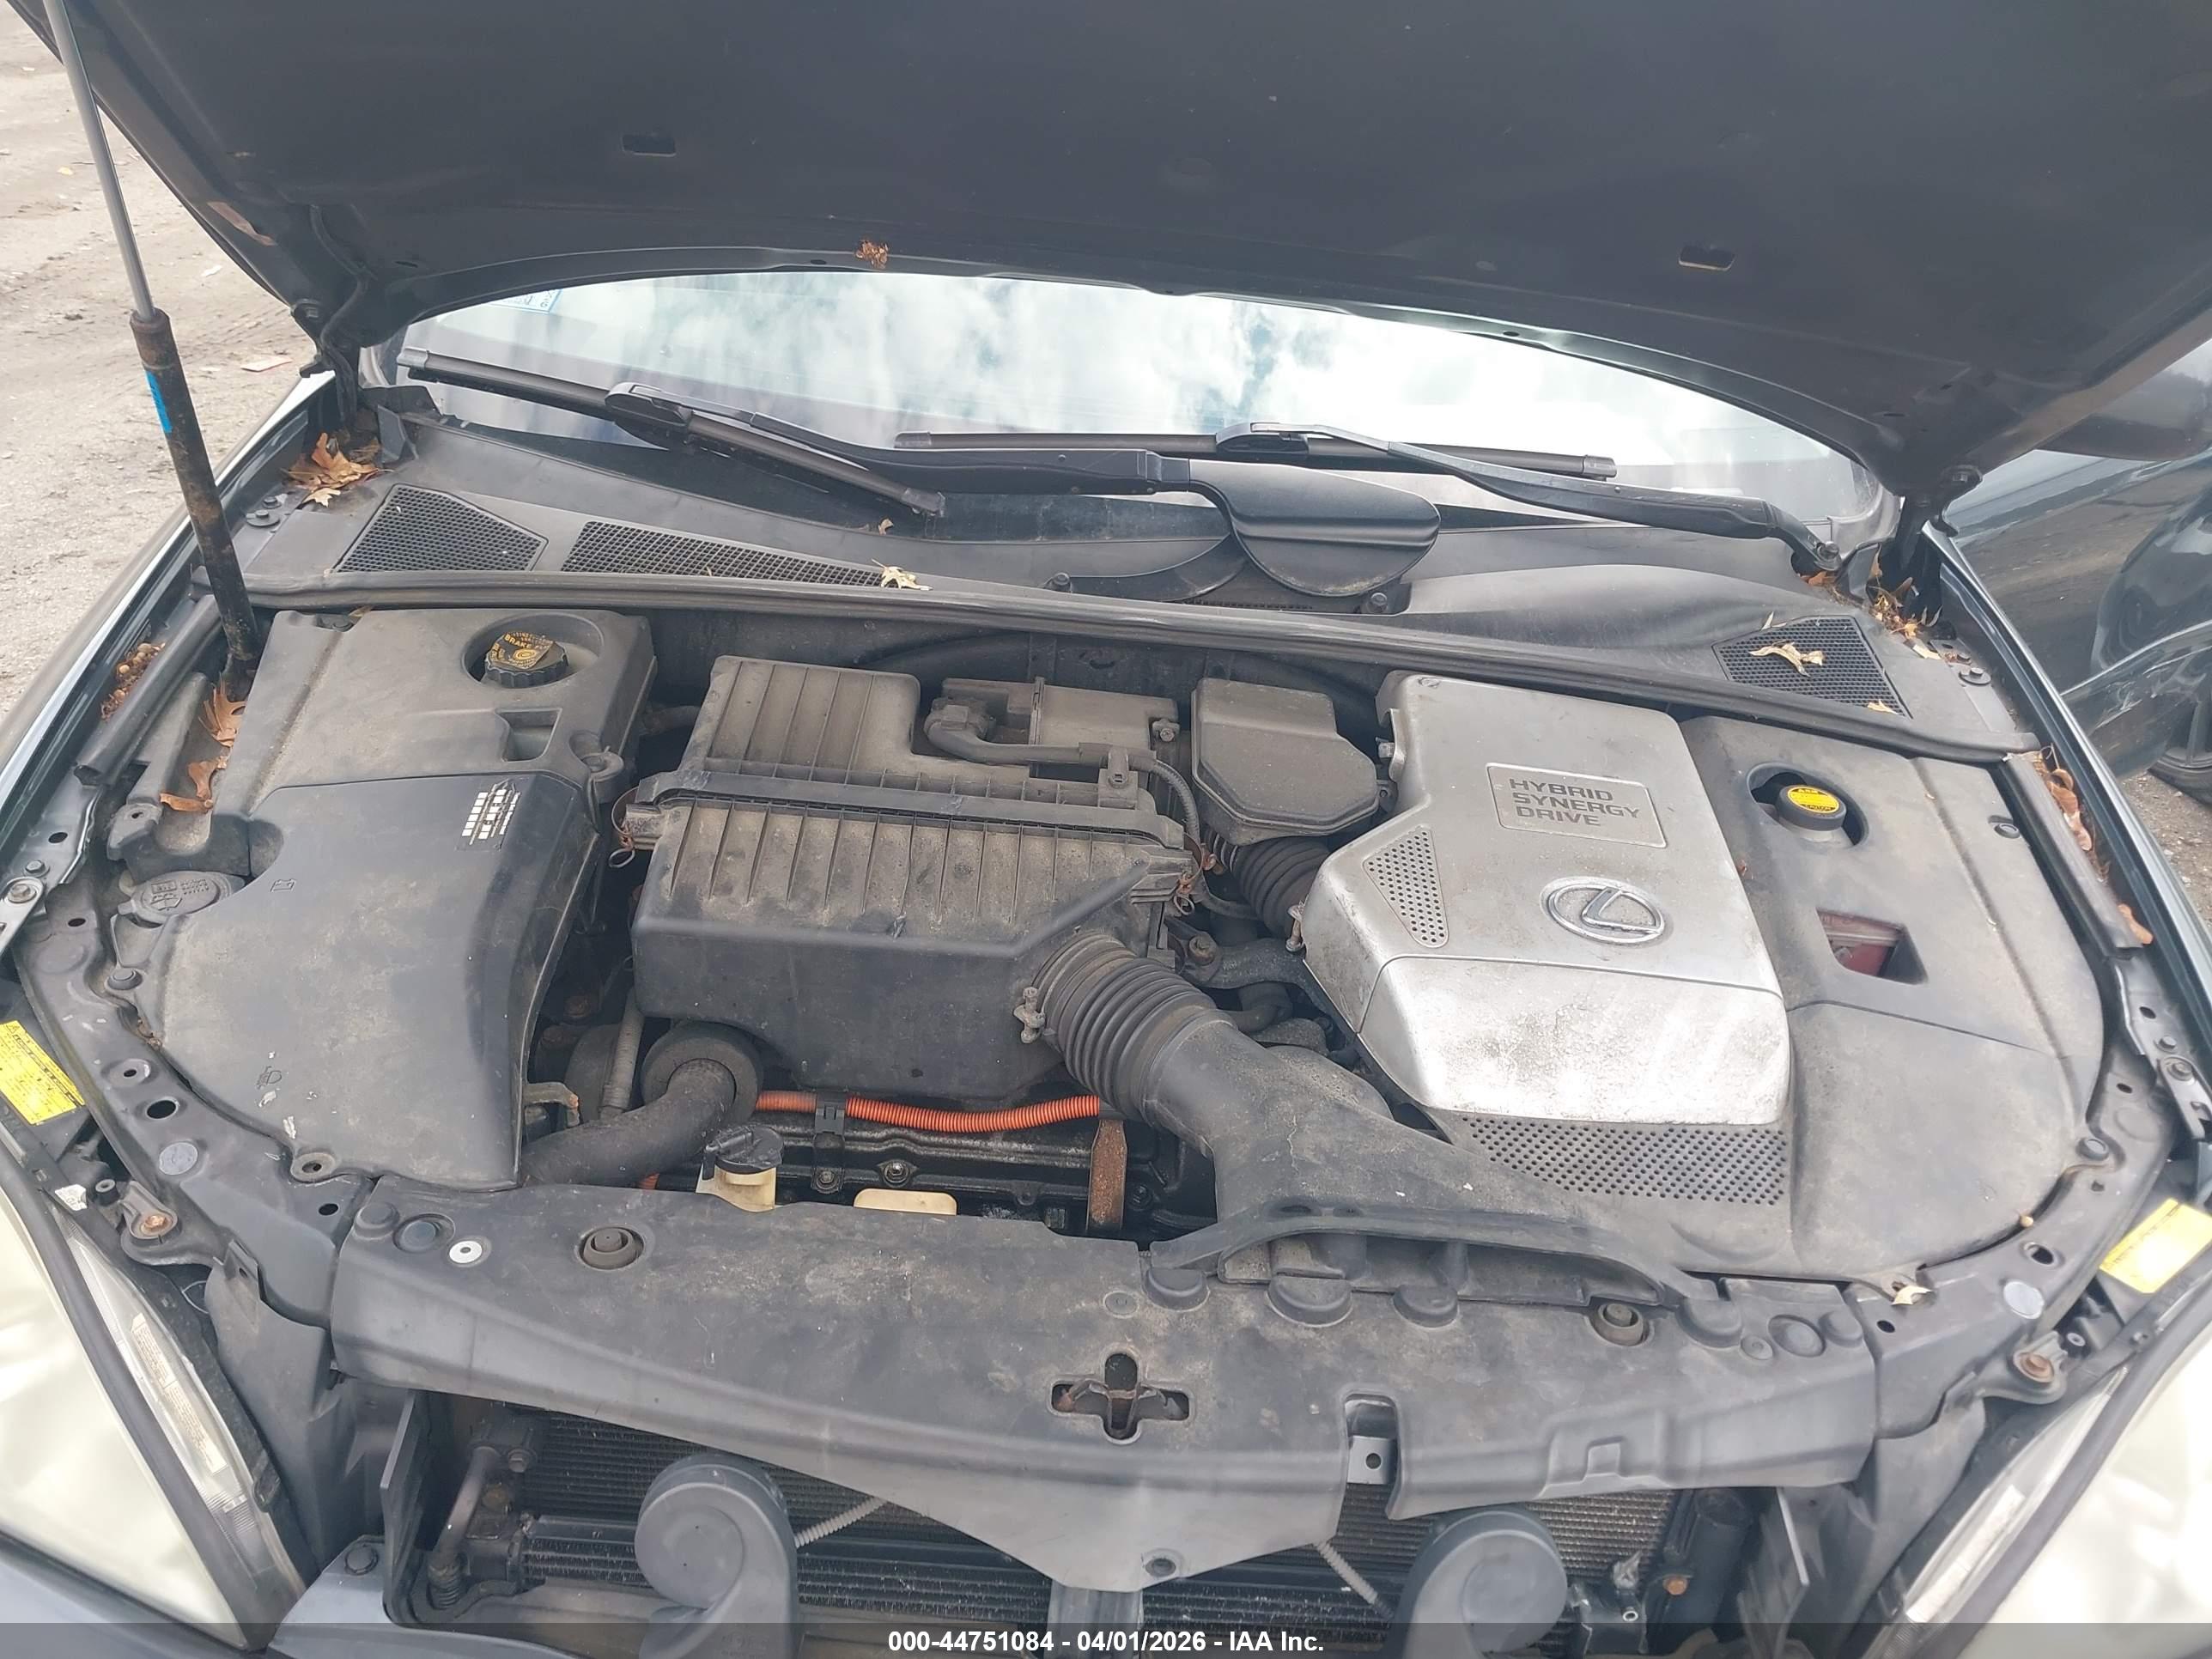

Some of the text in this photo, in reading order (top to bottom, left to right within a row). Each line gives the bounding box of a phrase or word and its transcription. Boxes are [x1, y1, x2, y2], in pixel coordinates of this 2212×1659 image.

[504, 634, 532, 648] BRAKE
[1510, 778, 1613, 801] HYBRID
[1512, 792, 1640, 817] SYNERGY
[1516, 806, 1601, 826] DRIVE
